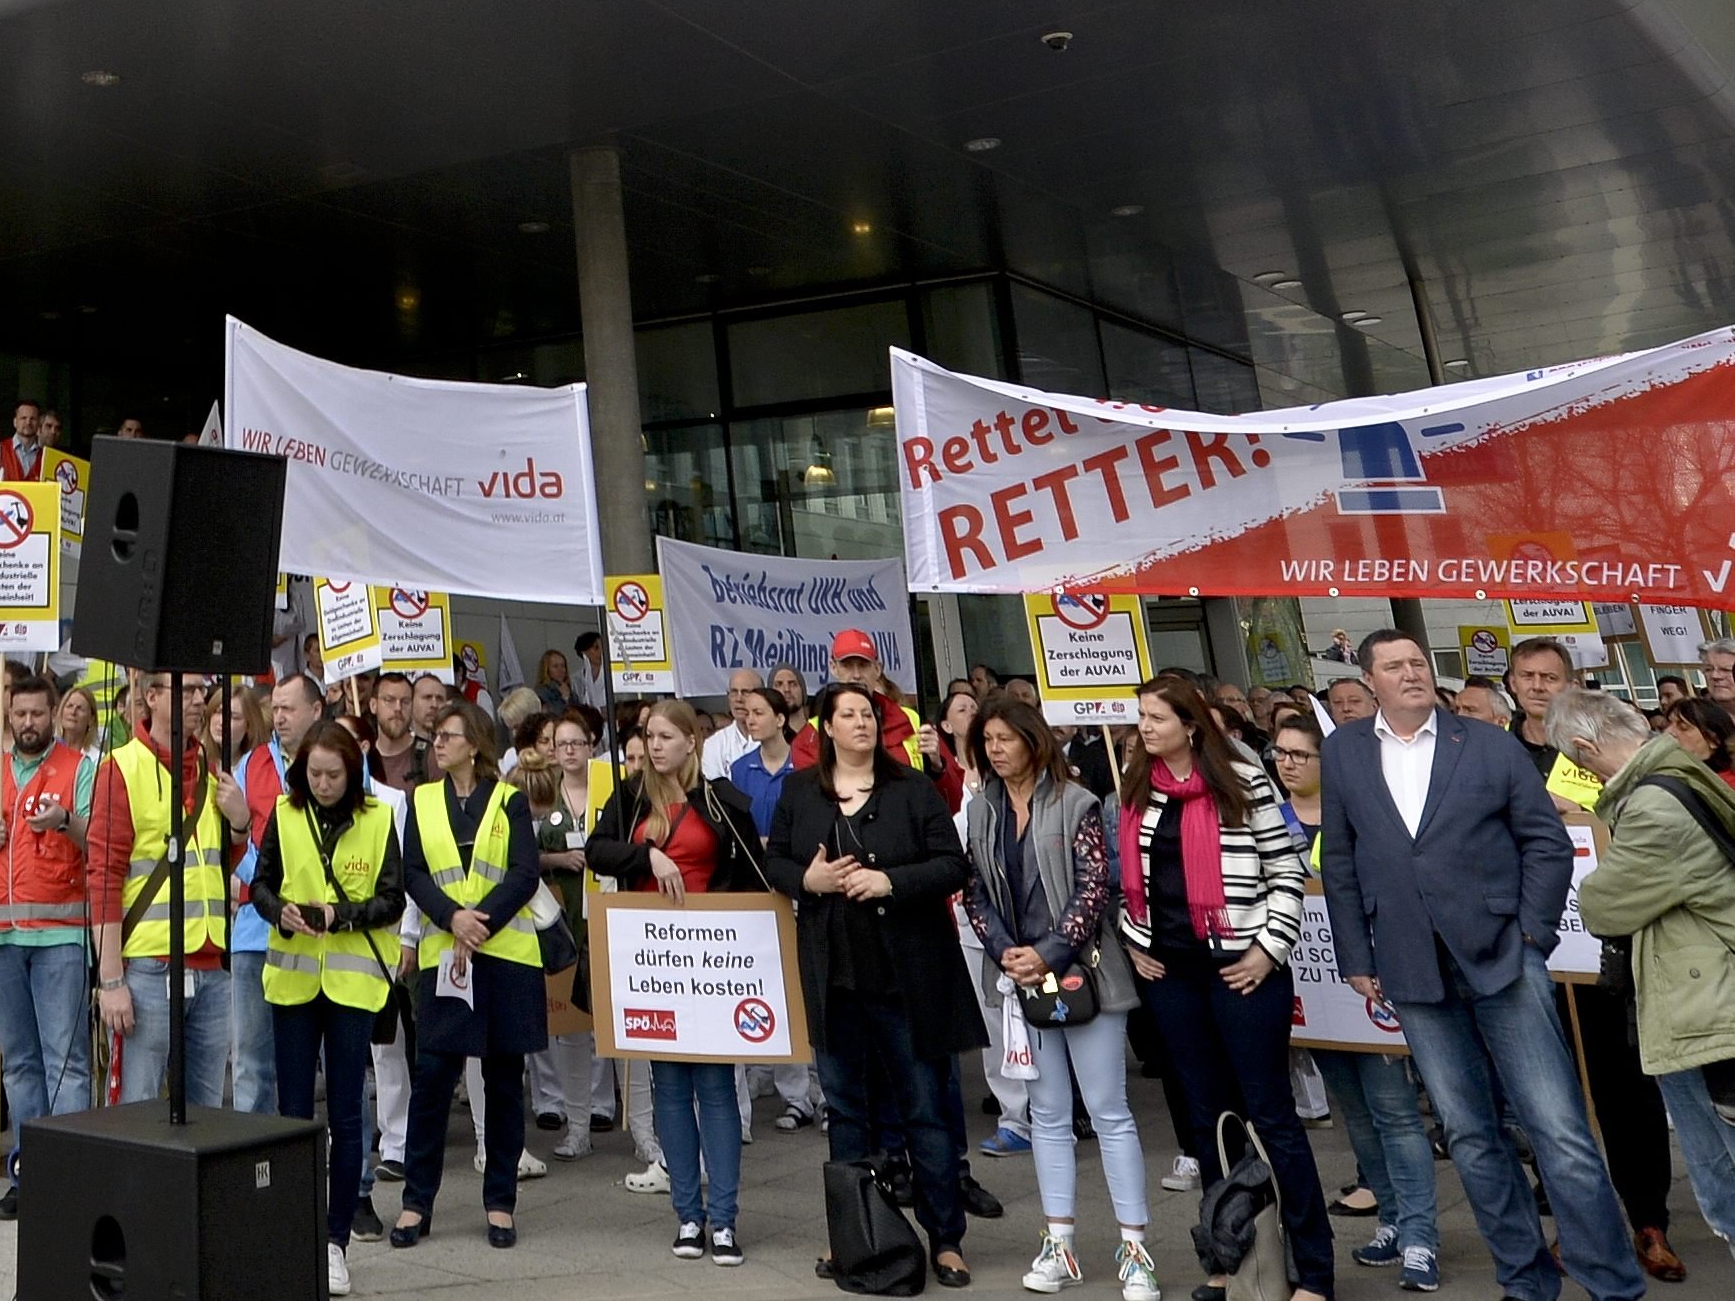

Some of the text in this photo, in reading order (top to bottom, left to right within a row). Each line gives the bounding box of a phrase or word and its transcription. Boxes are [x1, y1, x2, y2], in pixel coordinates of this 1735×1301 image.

[242, 427, 272, 453] WIR
[274, 436, 326, 468] LEBEN
[477, 457, 563, 499] vida
[937, 428, 1271, 581] RETTER!
[491, 512, 565, 524] www.vida.at
[1280, 559, 1336, 582] WIR
[1343, 559, 1429, 583] LEBEN
[1437, 559, 1682, 589] GEWERKSCHAFT
[17, 582, 32, 590] der
[808, 577, 847, 615] UKH
[848, 573, 887, 613] und
[1523, 608, 1574, 617] der AUVA!
[382, 633, 441, 641] Zerschlagung
[1068, 632, 1104, 642] Keine
[1661, 627, 1687, 635] WEG!
[389, 645, 404, 653] der
[710, 624, 743, 669] RZ
[744, 627, 830, 685] Meidling
[1048, 649, 1133, 661] Zerschlagung
[1060, 664, 1126, 677] der AUVA!
[1074, 702, 1106, 714] GPA
[645, 922, 737, 941] Reformen
[635, 949, 755, 969] dürfen keine
[1299, 967, 1321, 983] ZU
[629, 975, 764, 996] Leben kosten!
[625, 1016, 650, 1030] SPÖ
